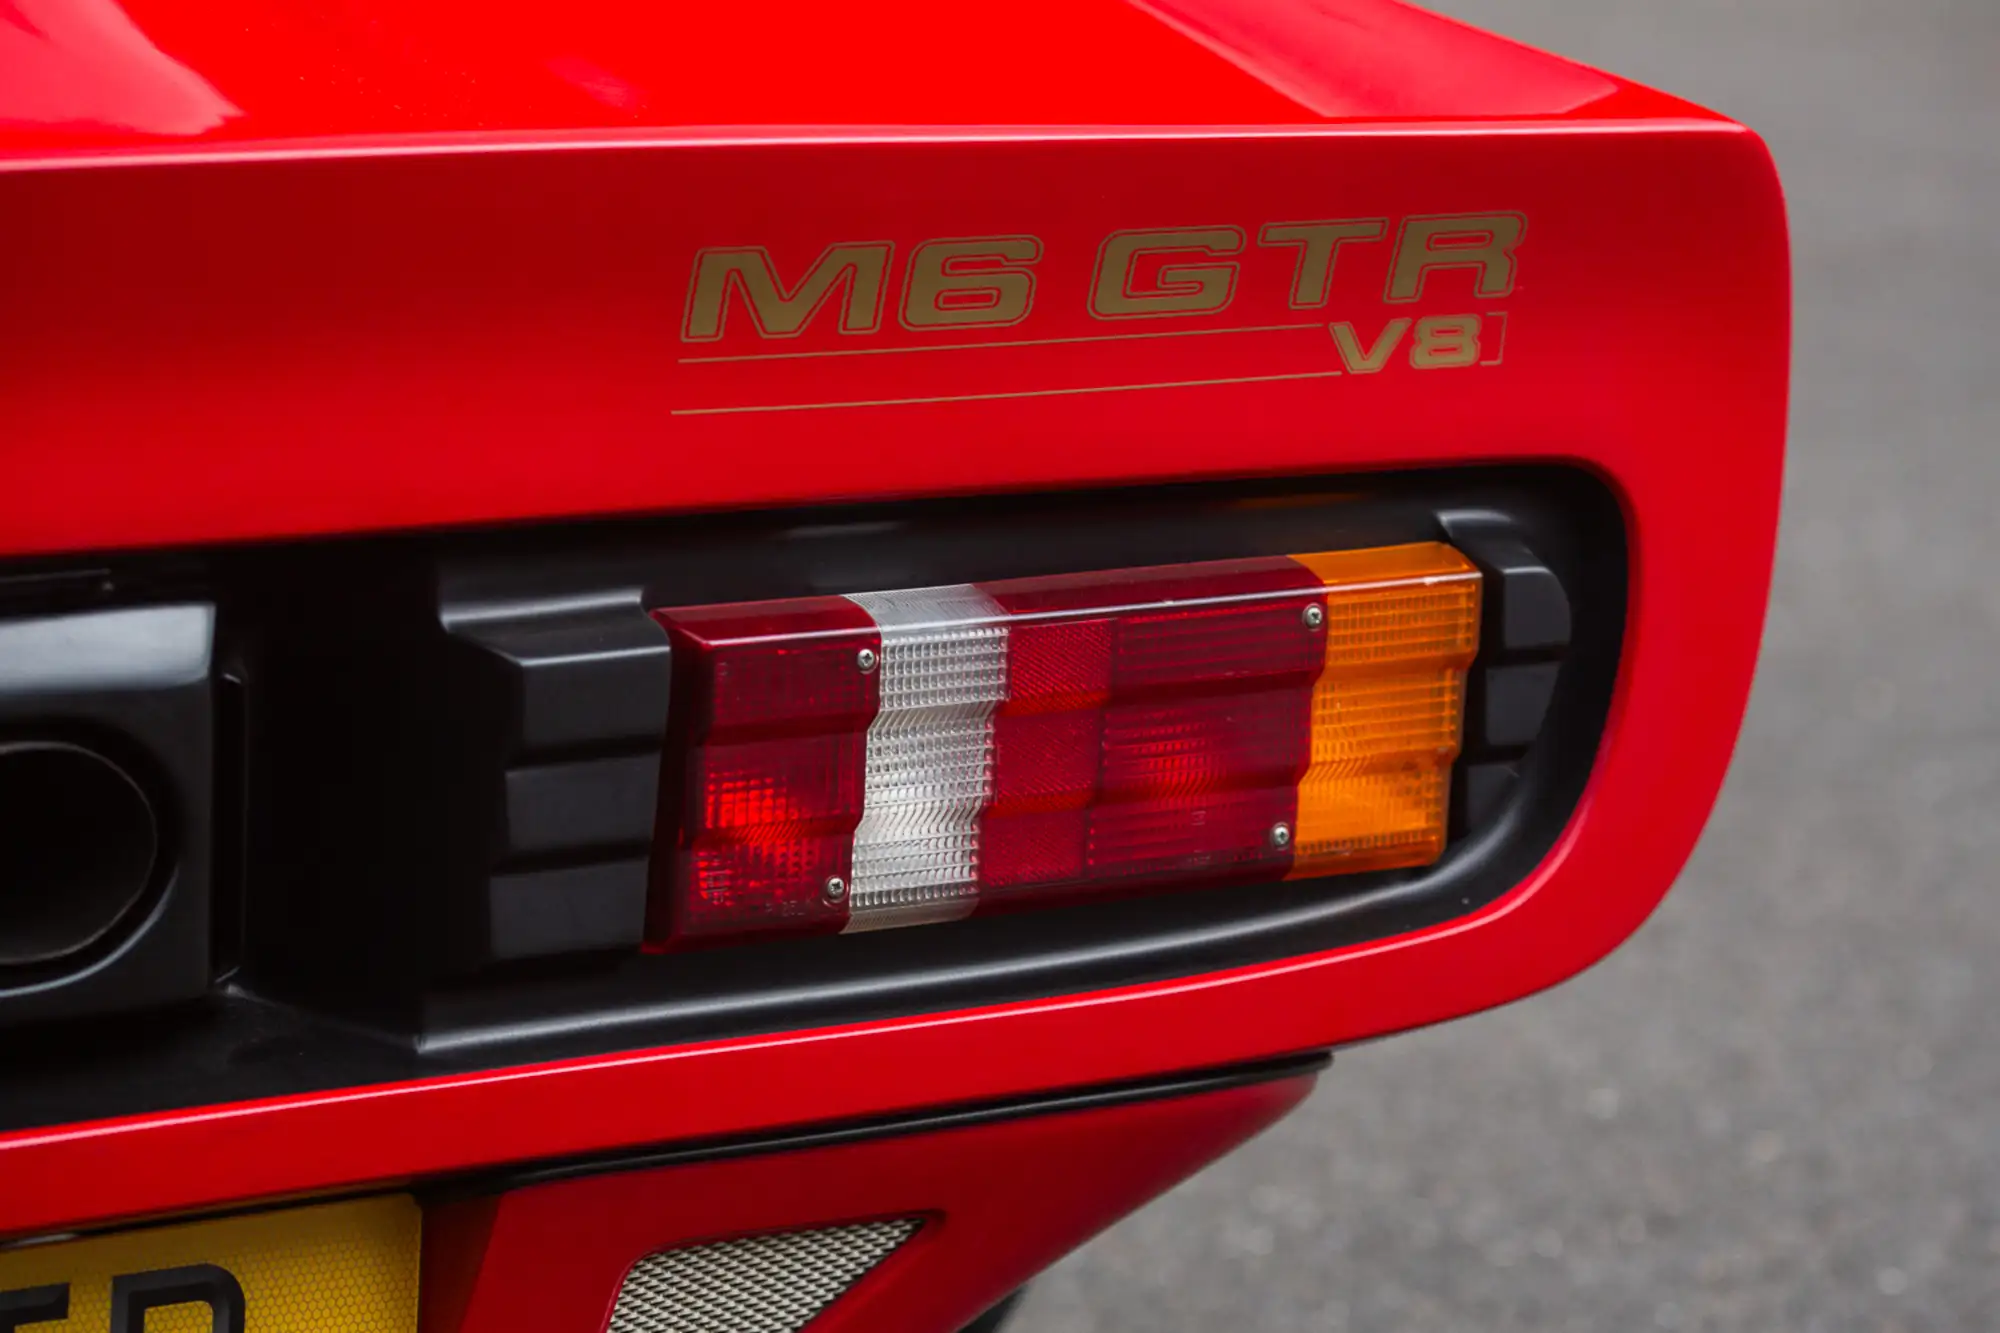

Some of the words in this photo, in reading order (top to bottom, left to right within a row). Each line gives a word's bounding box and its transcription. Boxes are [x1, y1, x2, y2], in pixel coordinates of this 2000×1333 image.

[680, 235, 1044, 342] M6
[1087, 211, 1528, 320] GTR
[1328, 313, 1482, 374] V8
